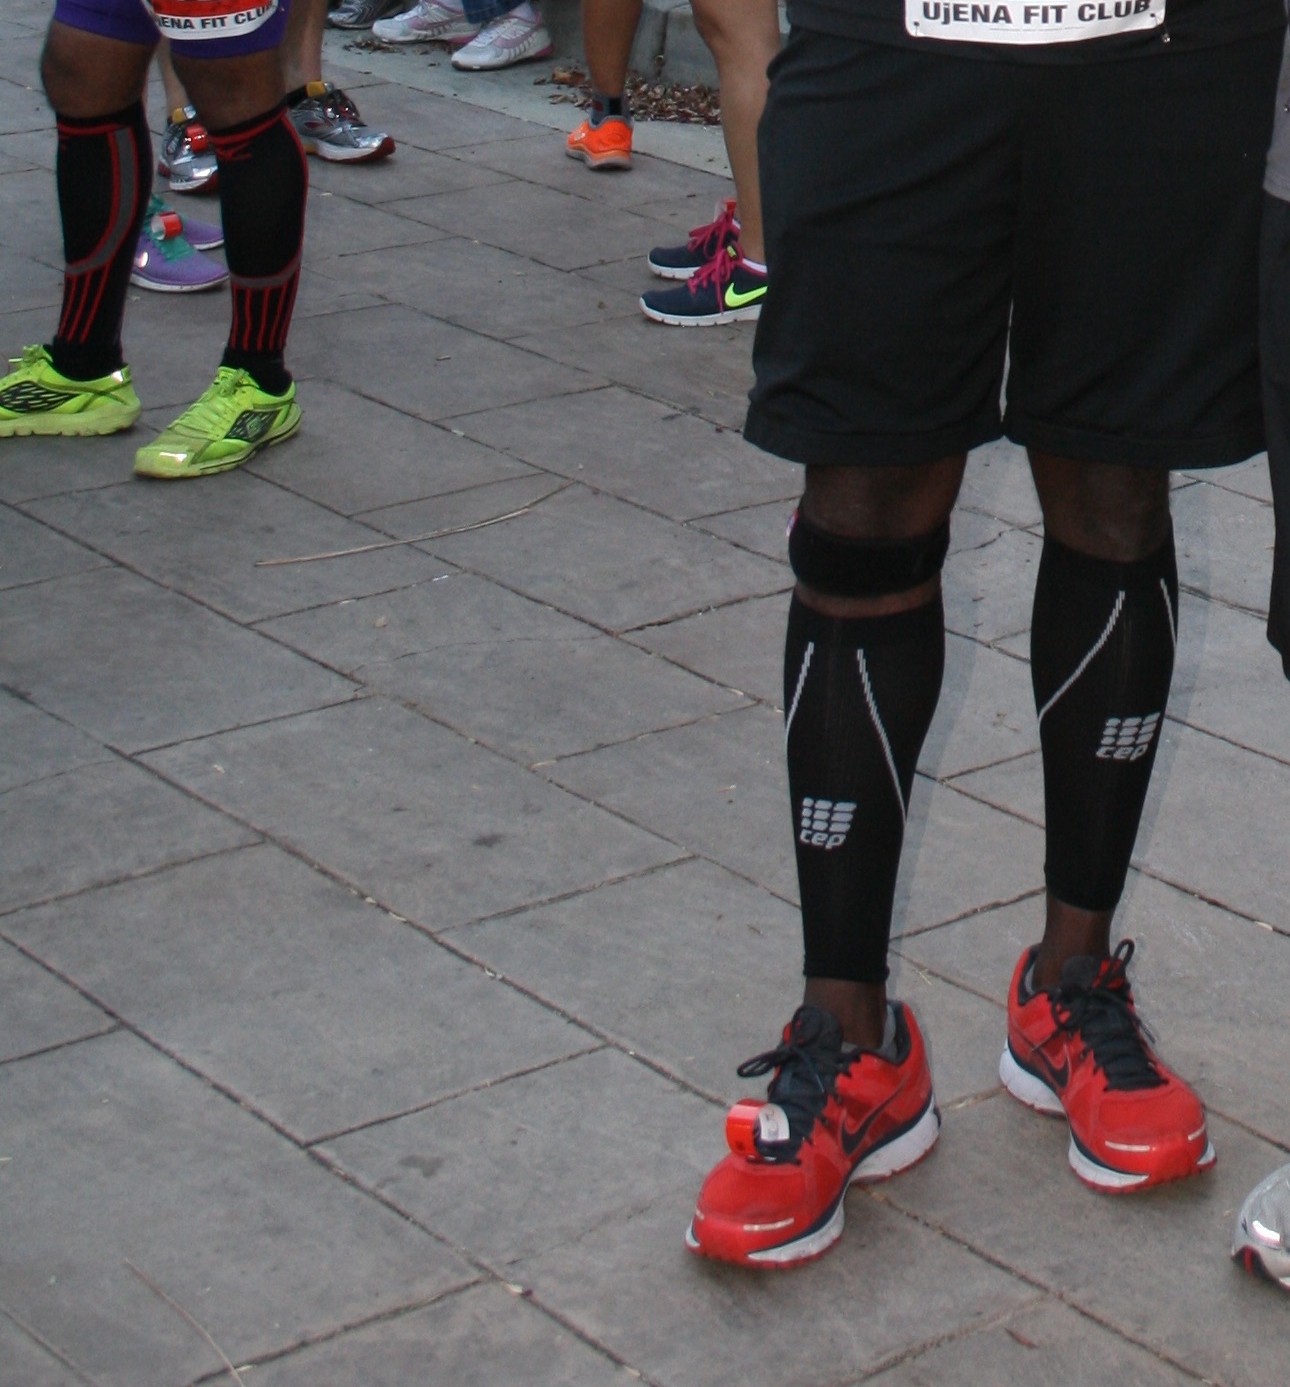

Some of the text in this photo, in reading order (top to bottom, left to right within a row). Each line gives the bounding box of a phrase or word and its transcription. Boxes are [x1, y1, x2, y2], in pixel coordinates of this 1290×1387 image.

[157, 16, 196, 30] ENA
[200, 15, 230, 30] FIT
[922, 1, 1013, 25] UjENA
[1023, 4, 1068, 25] FIT
[1095, 742, 1150, 762] cep
[800, 829, 847, 851] cep
